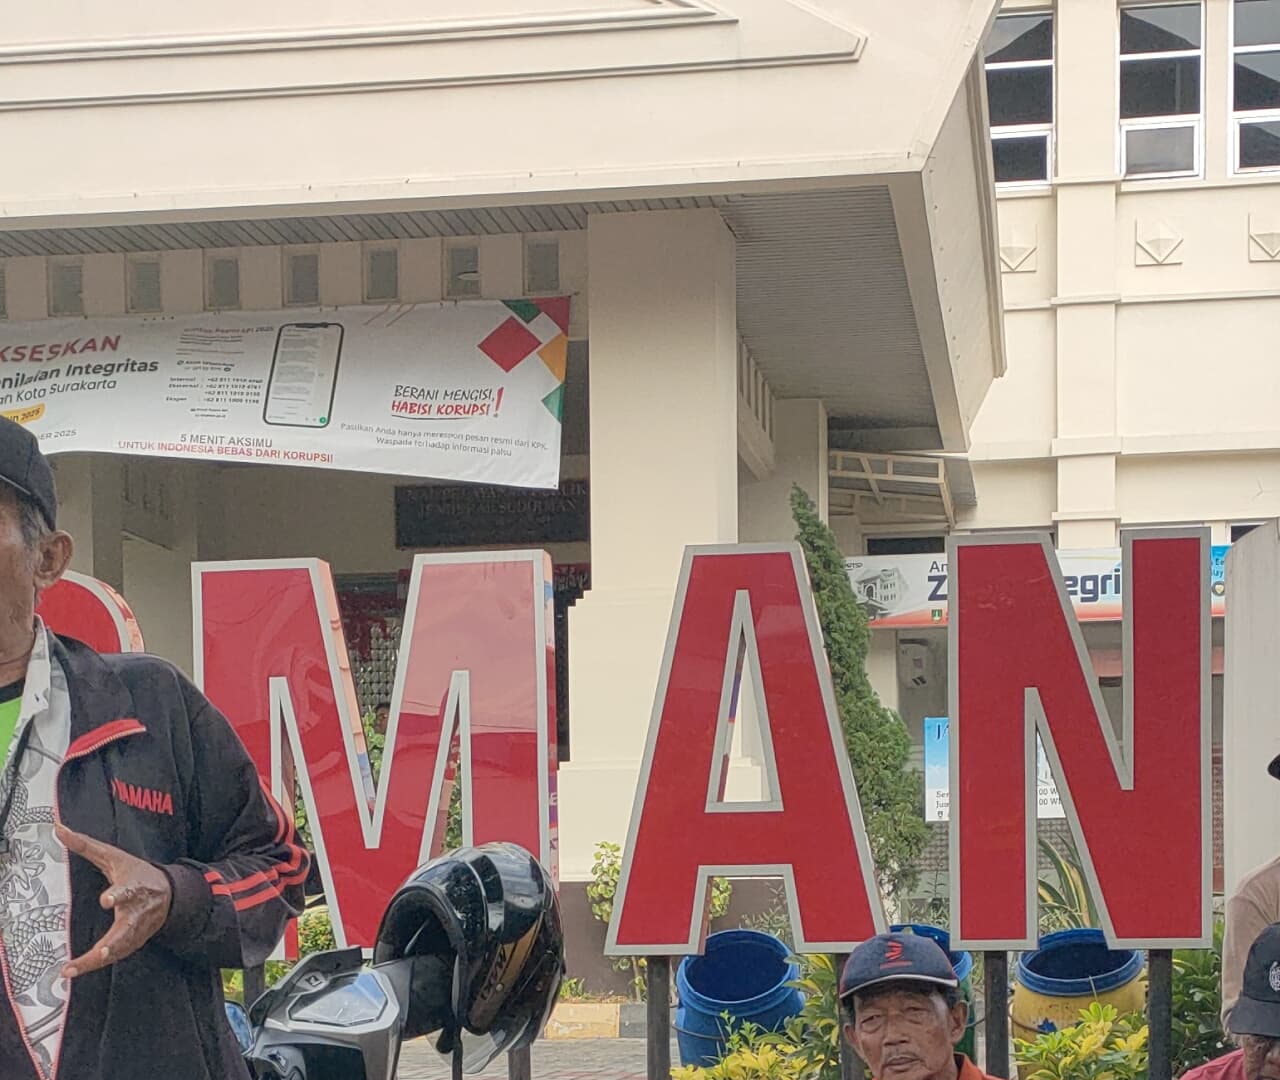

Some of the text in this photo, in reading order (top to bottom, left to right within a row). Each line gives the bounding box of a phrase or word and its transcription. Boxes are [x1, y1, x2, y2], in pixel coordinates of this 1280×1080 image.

[65, 357, 160, 378] Integritas
[16, 387, 47, 402] Kota
[49, 379, 118, 394] Surakarta
[394, 385, 439, 400] BERANI
[21, 407, 41, 420] 2025
[391, 401, 432, 415] HABISI
[436, 403, 490, 416] KORUPSI
[180, 434, 273, 448] 5 MENIT AKSIMU
[398, 430, 421, 439] hanya
[118, 441, 155, 451] UNTUK
[157, 442, 214, 454] INDONESIA
[217, 446, 253, 457] BEBAS
[255, 448, 280, 459] DARI
